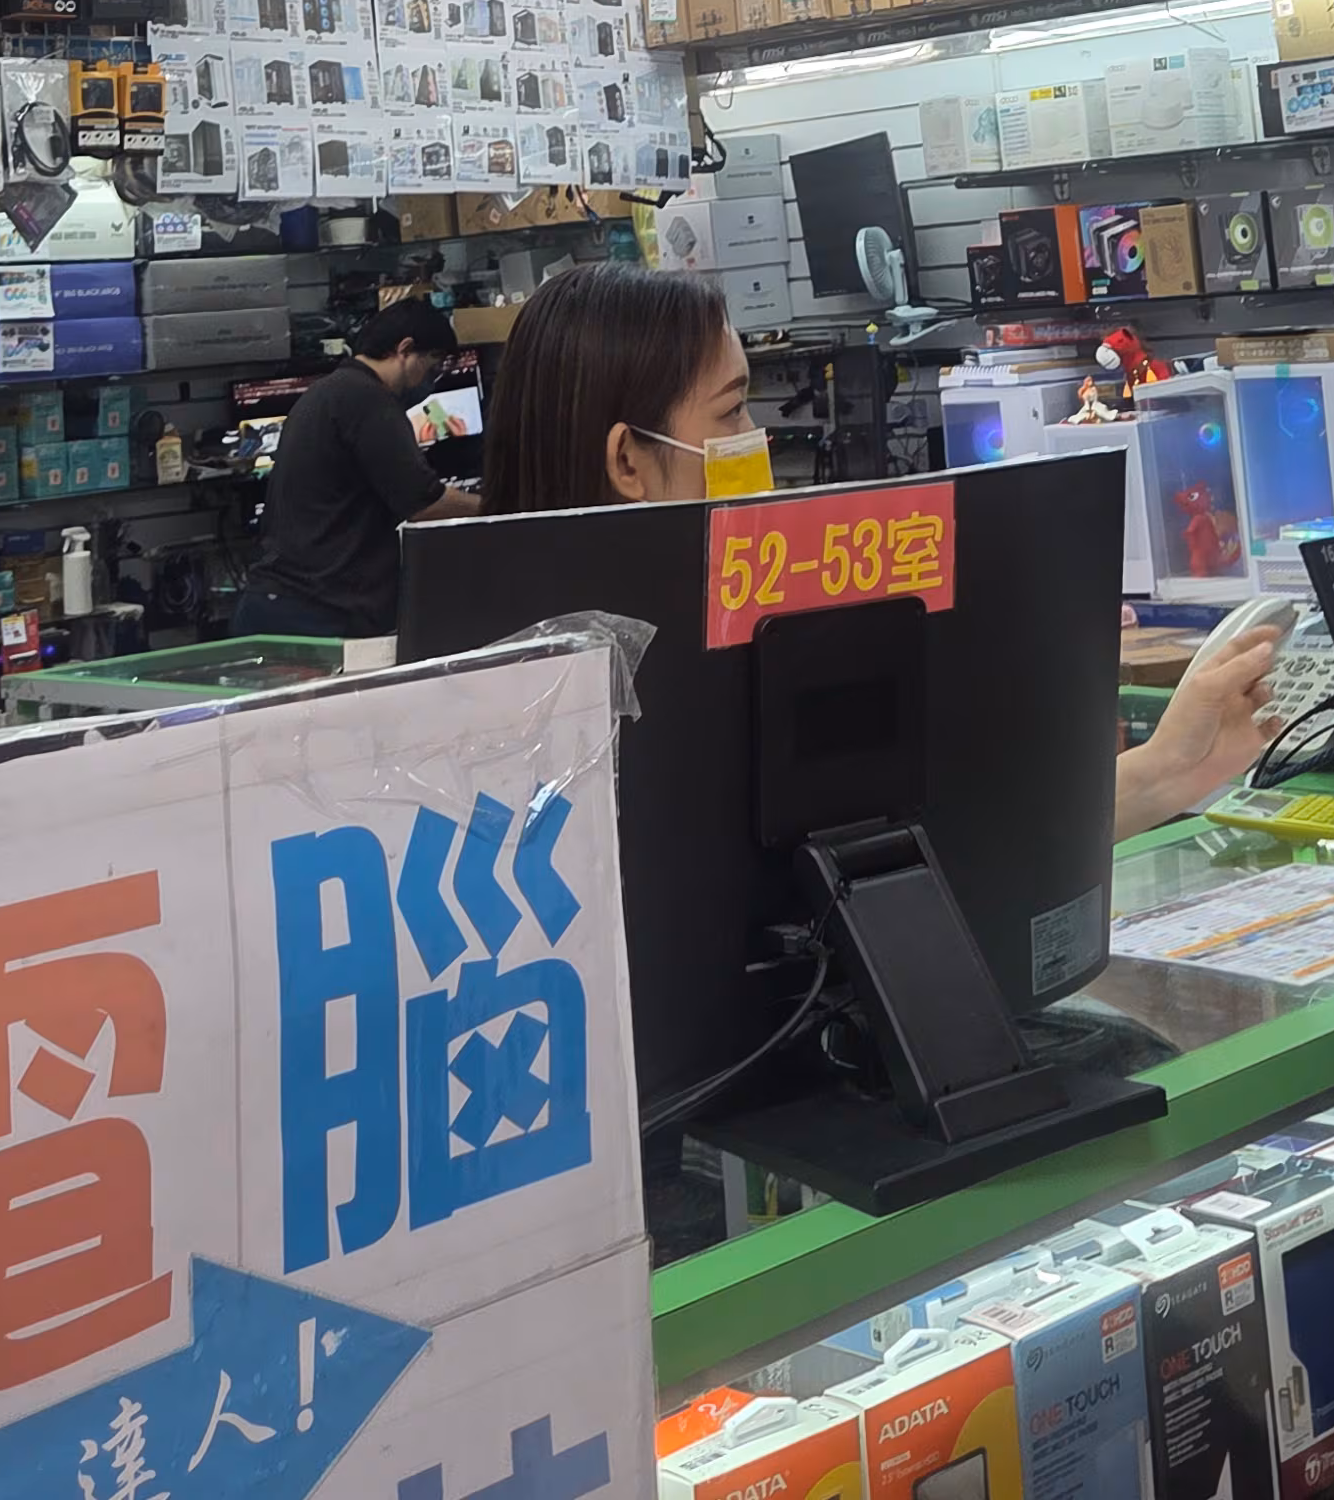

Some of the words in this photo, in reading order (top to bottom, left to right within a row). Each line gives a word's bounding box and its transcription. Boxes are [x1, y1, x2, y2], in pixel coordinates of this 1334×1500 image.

[721, 511, 943, 610] 52-53室
[1161, 1350, 1190, 1380] ONE
[1192, 1323, 1242, 1364] TOUCH
[879, 1398, 949, 1444] ADATA
[1030, 1405, 1062, 1435] ONE
[1067, 1373, 1120, 1416] TOUCH
